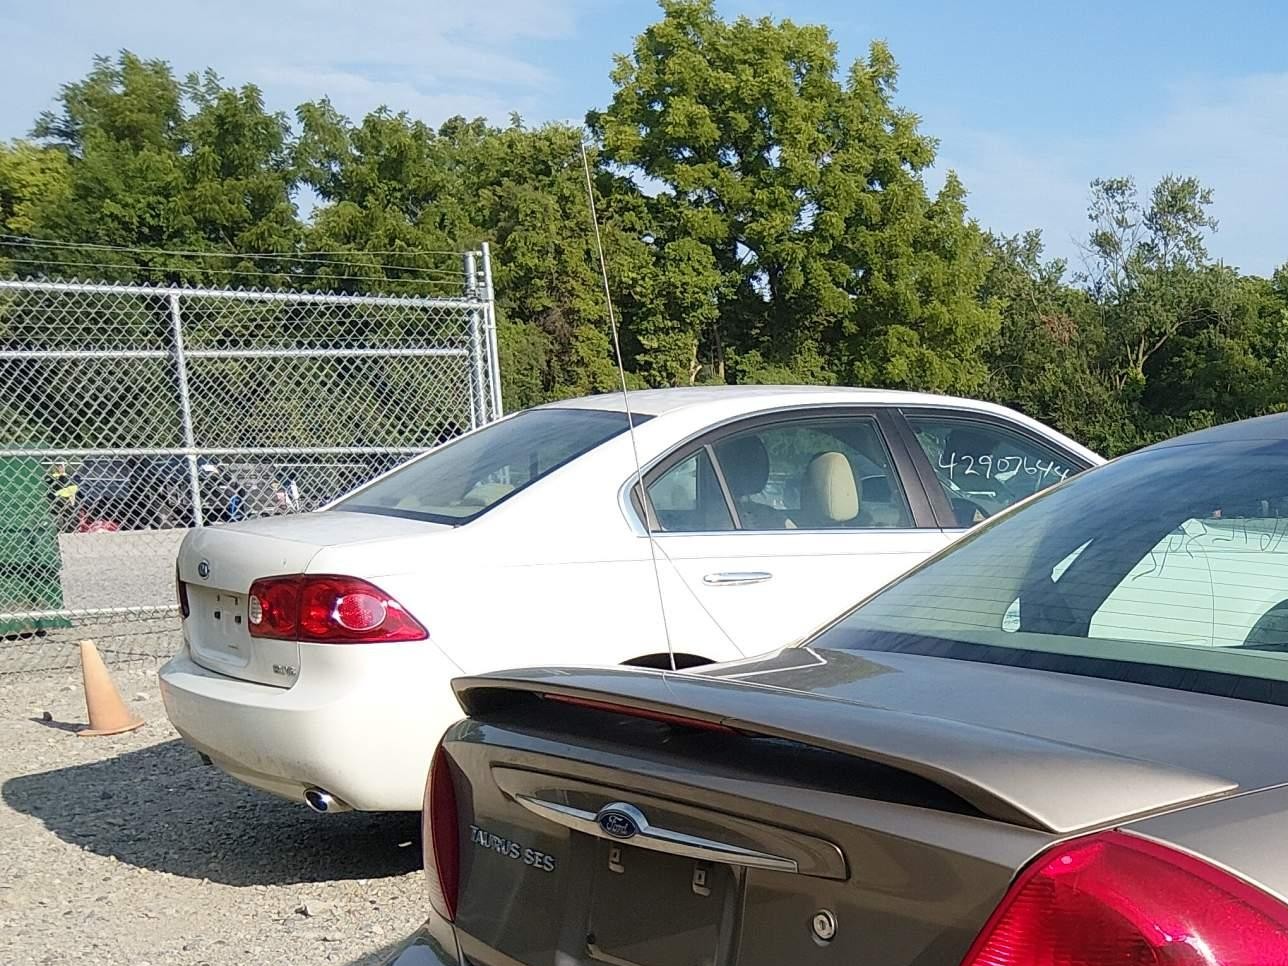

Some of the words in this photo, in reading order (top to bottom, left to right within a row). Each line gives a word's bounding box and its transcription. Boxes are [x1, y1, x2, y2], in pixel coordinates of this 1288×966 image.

[938, 452, 1070, 482] 42907644
[606, 814, 628, 834] Ford
[469, 824, 521, 860] TAURUS
[523, 847, 556, 873] SES
